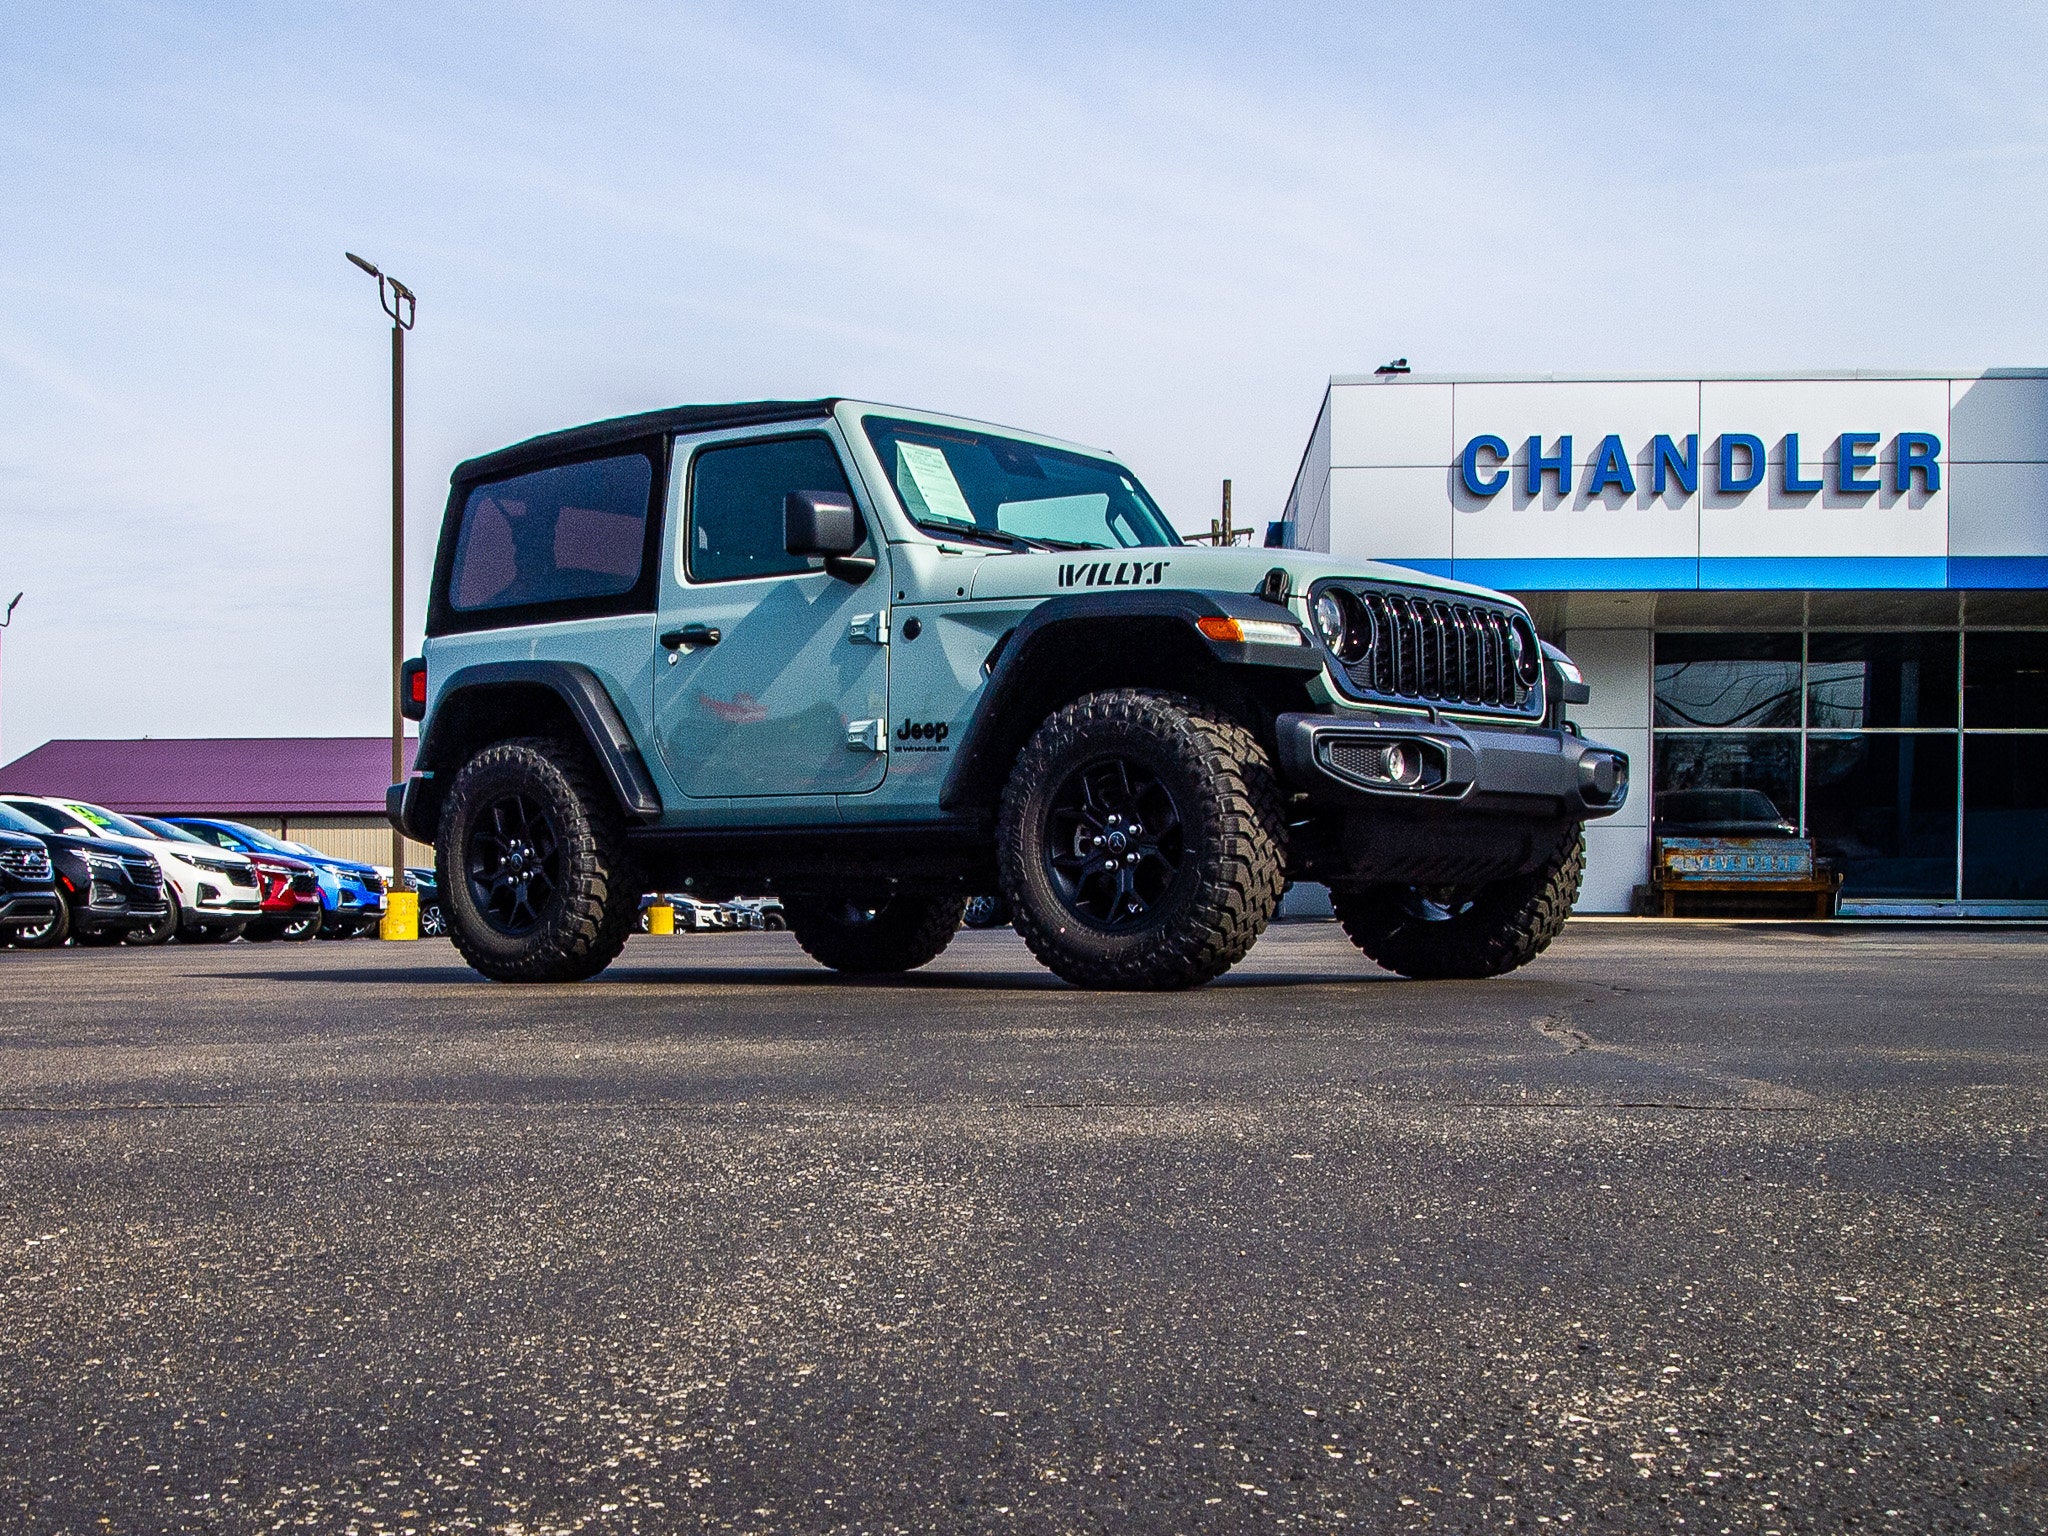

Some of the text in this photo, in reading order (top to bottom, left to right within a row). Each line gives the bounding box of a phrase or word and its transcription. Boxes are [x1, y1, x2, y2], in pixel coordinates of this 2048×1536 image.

[1461, 432, 1942, 496] CHANDLER
[1058, 561, 1171, 588] WILLYS
[896, 718, 949, 743] Jeep
